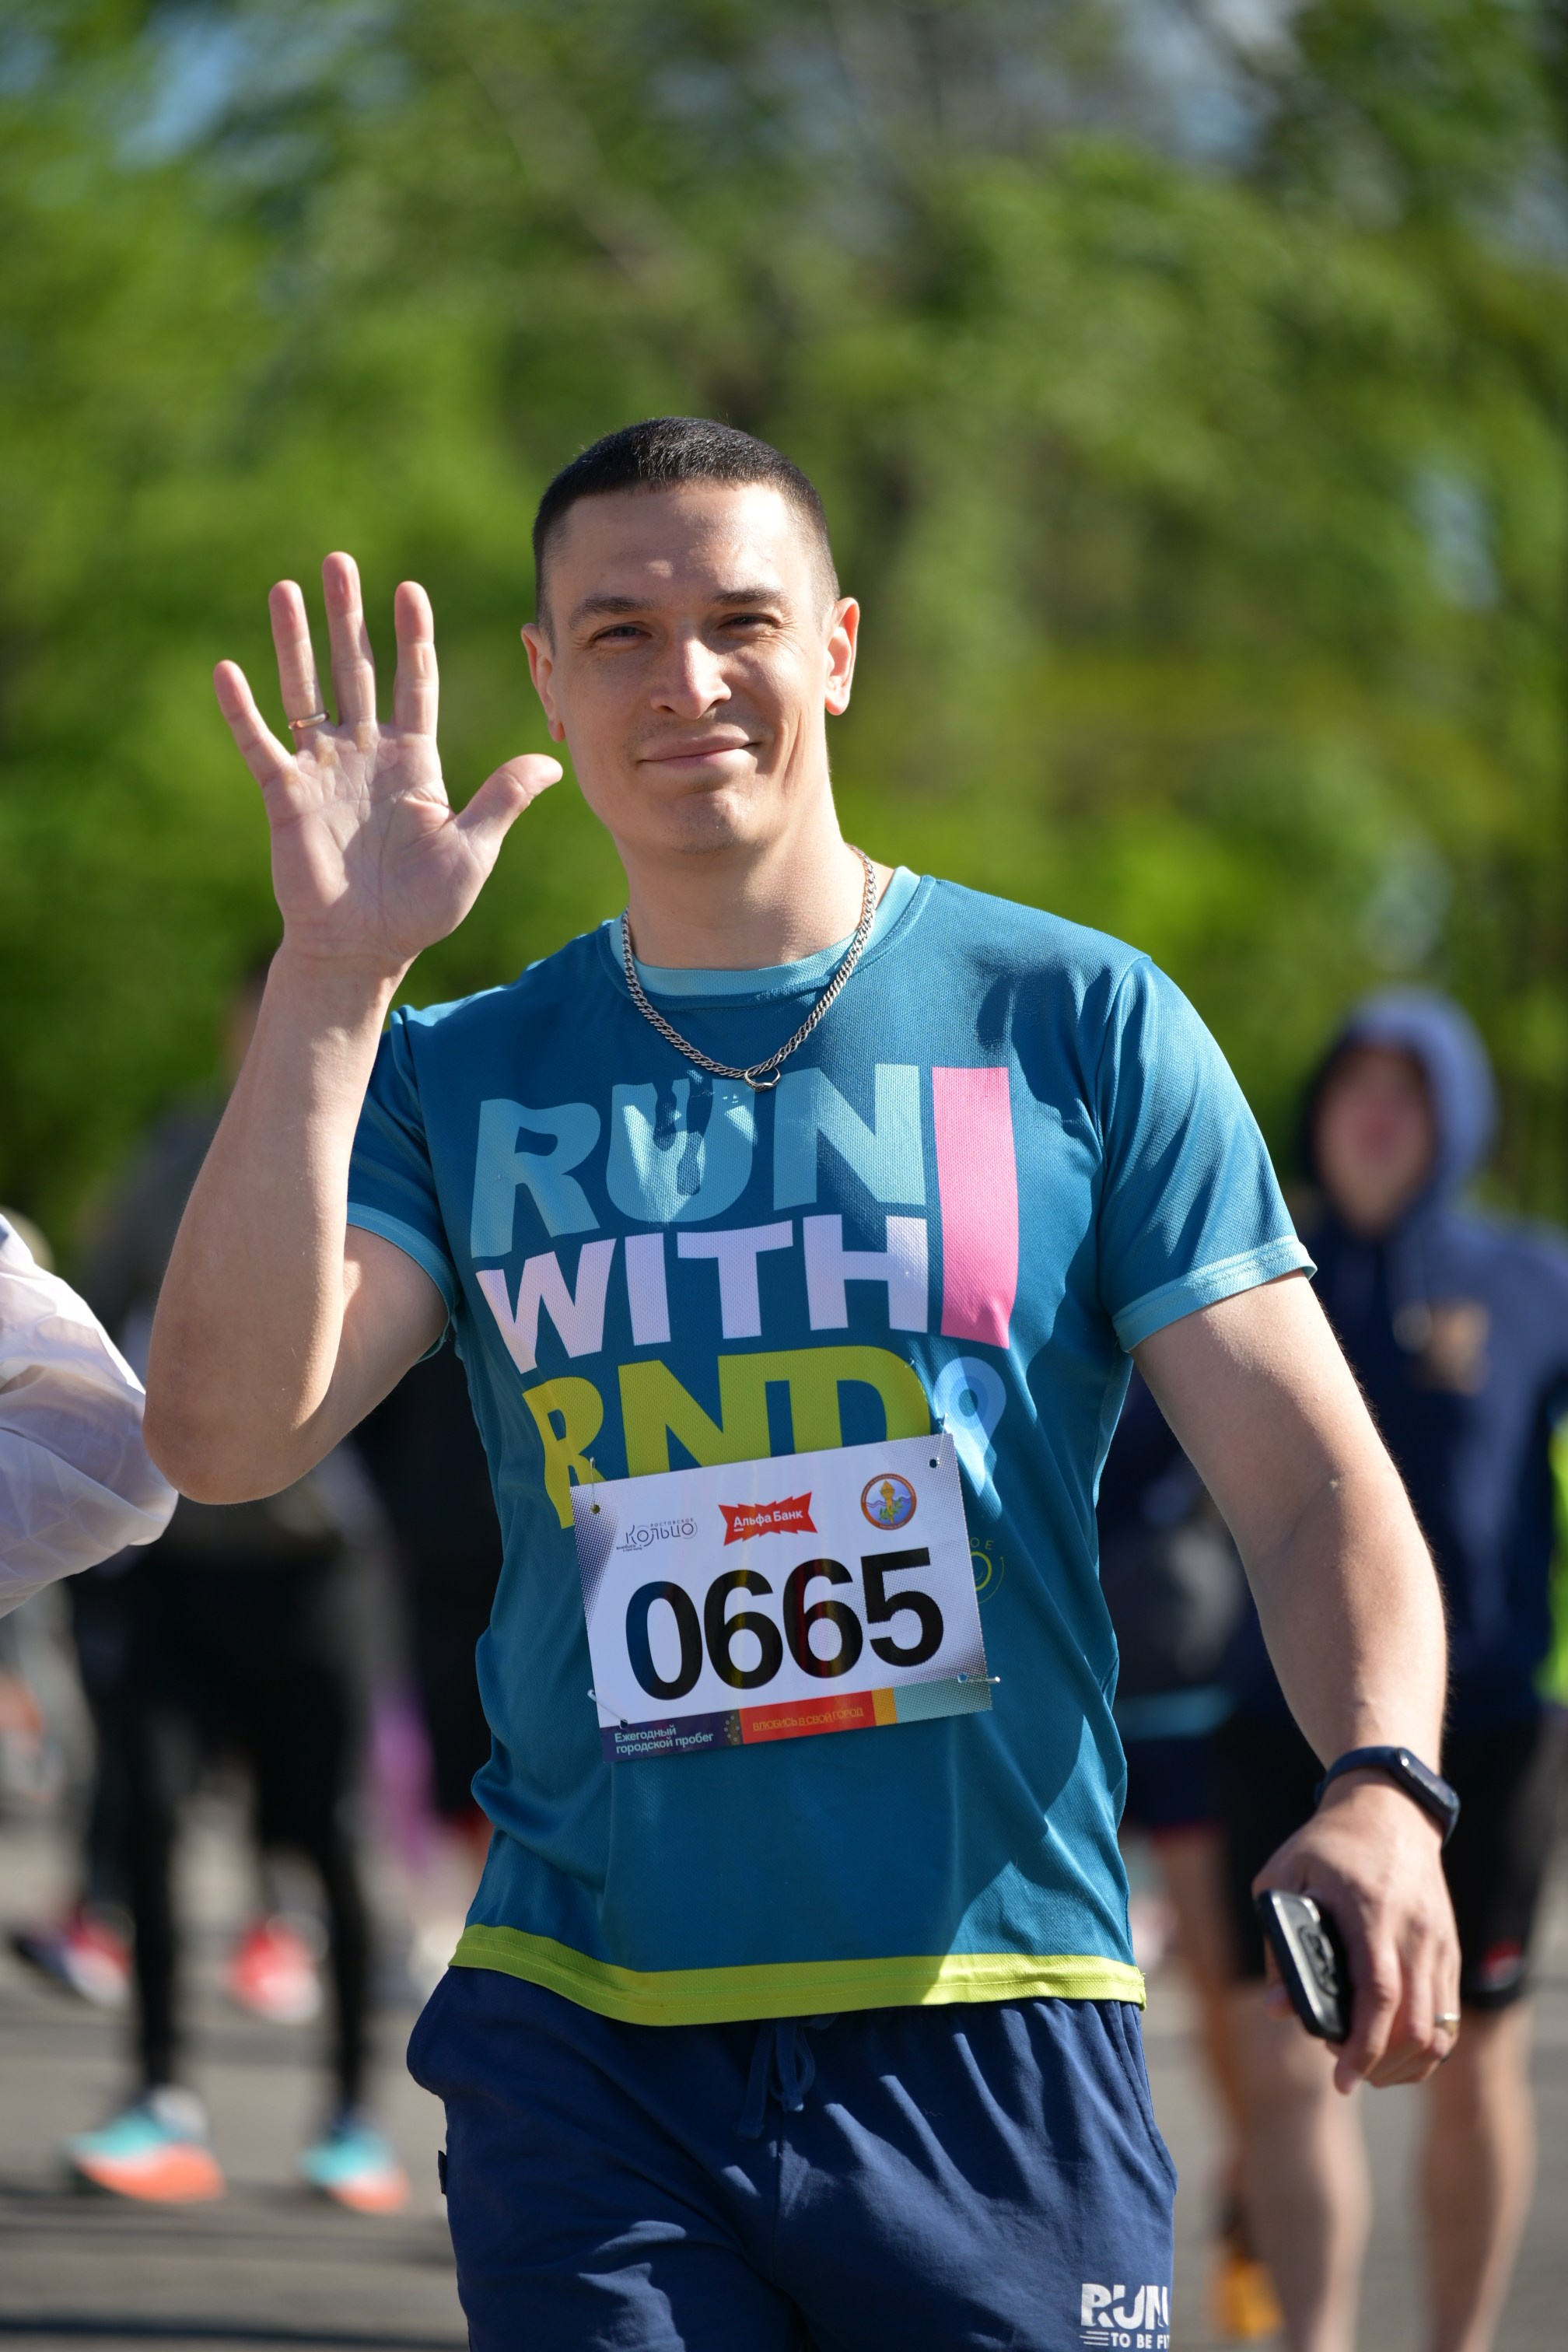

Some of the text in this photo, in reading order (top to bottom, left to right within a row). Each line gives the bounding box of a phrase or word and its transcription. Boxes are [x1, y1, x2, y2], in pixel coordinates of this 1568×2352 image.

[470, 1063, 927, 1259] RUN
[475, 1214, 928, 1374] WITH
[522, 1346, 931, 1529] RND
[650, 1517, 694, 1528] РОСТОВСКОЕ
[733, 1510, 803, 1532] Альфа Банк
[625, 1547, 944, 1701] 0665
[752, 1707, 864, 1732] ВЛЮБИСЬ В СВОЙ ГОРОД
[614, 1724, 677, 1743] Ежегодный
[616, 1732, 714, 1755] городской пробег
[1080, 2283, 1169, 2330] RUN
[1111, 2333, 1132, 2348] TO
[1136, 2333, 1153, 2349] BE
